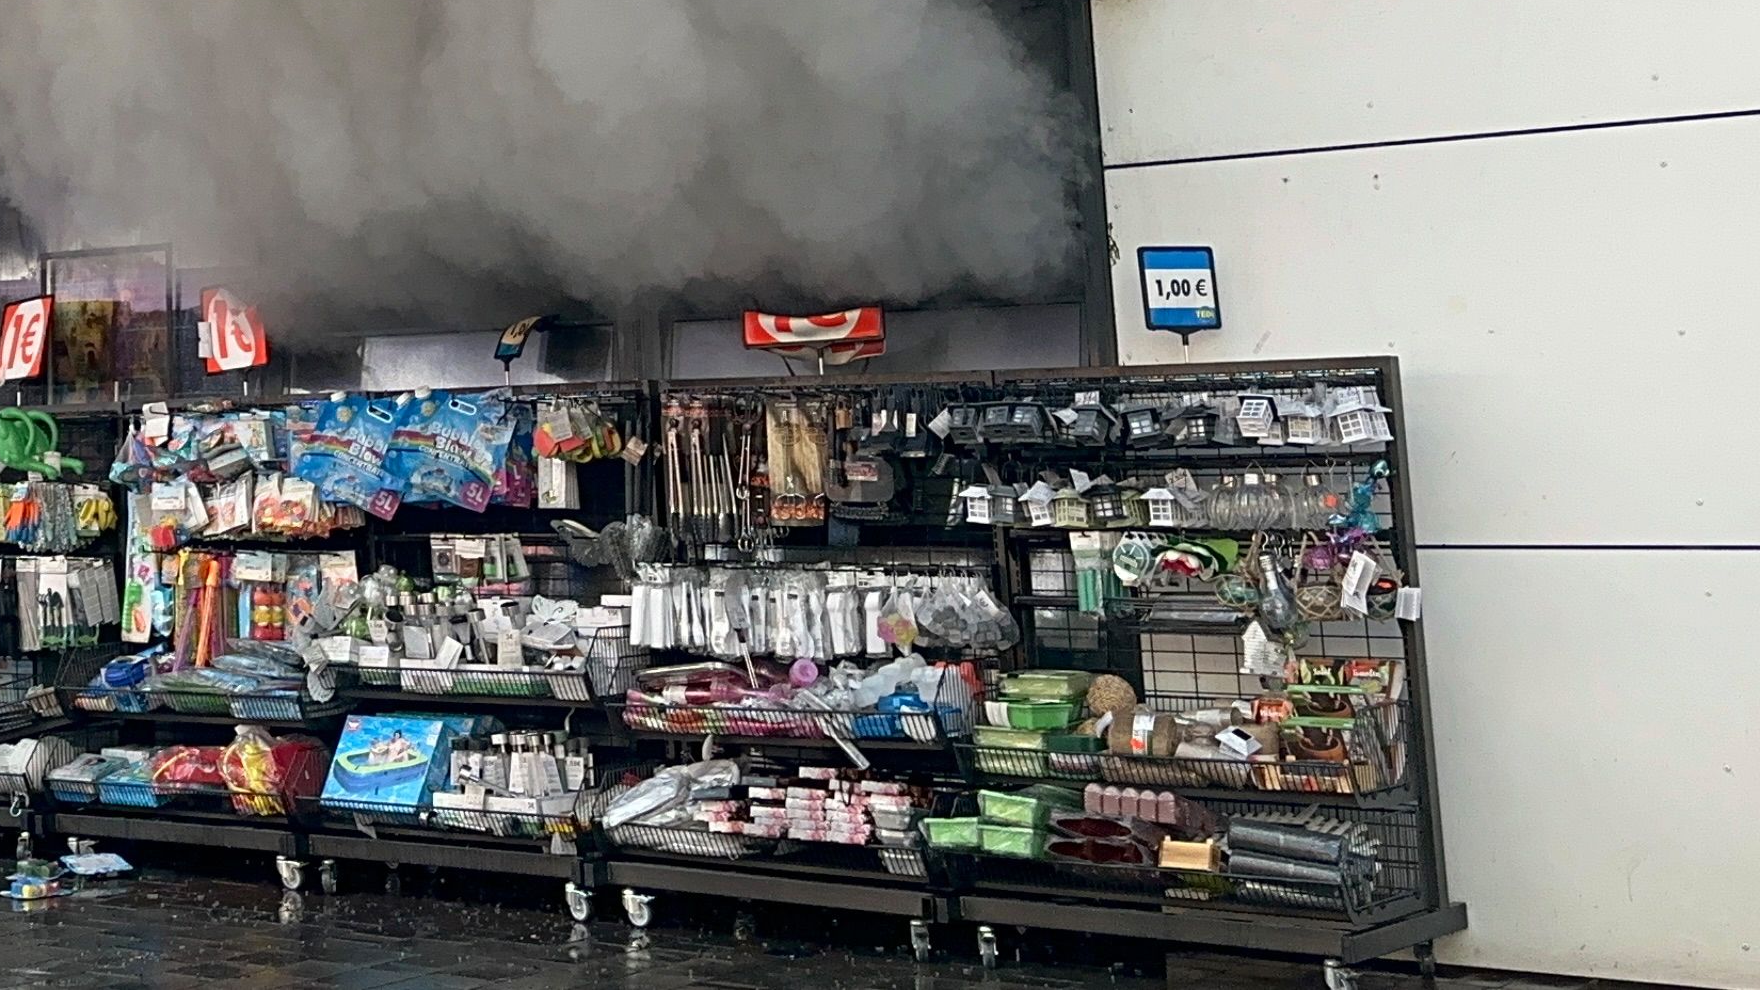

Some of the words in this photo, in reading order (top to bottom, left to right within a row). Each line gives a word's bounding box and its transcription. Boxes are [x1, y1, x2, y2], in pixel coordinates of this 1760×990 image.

[1155, 278, 1191, 301] 1,00
[1195, 278, 1208, 297] €
[7, 313, 41, 370] 1€
[213, 300, 252, 359] 1€
[348, 427, 389, 454] Bubbl
